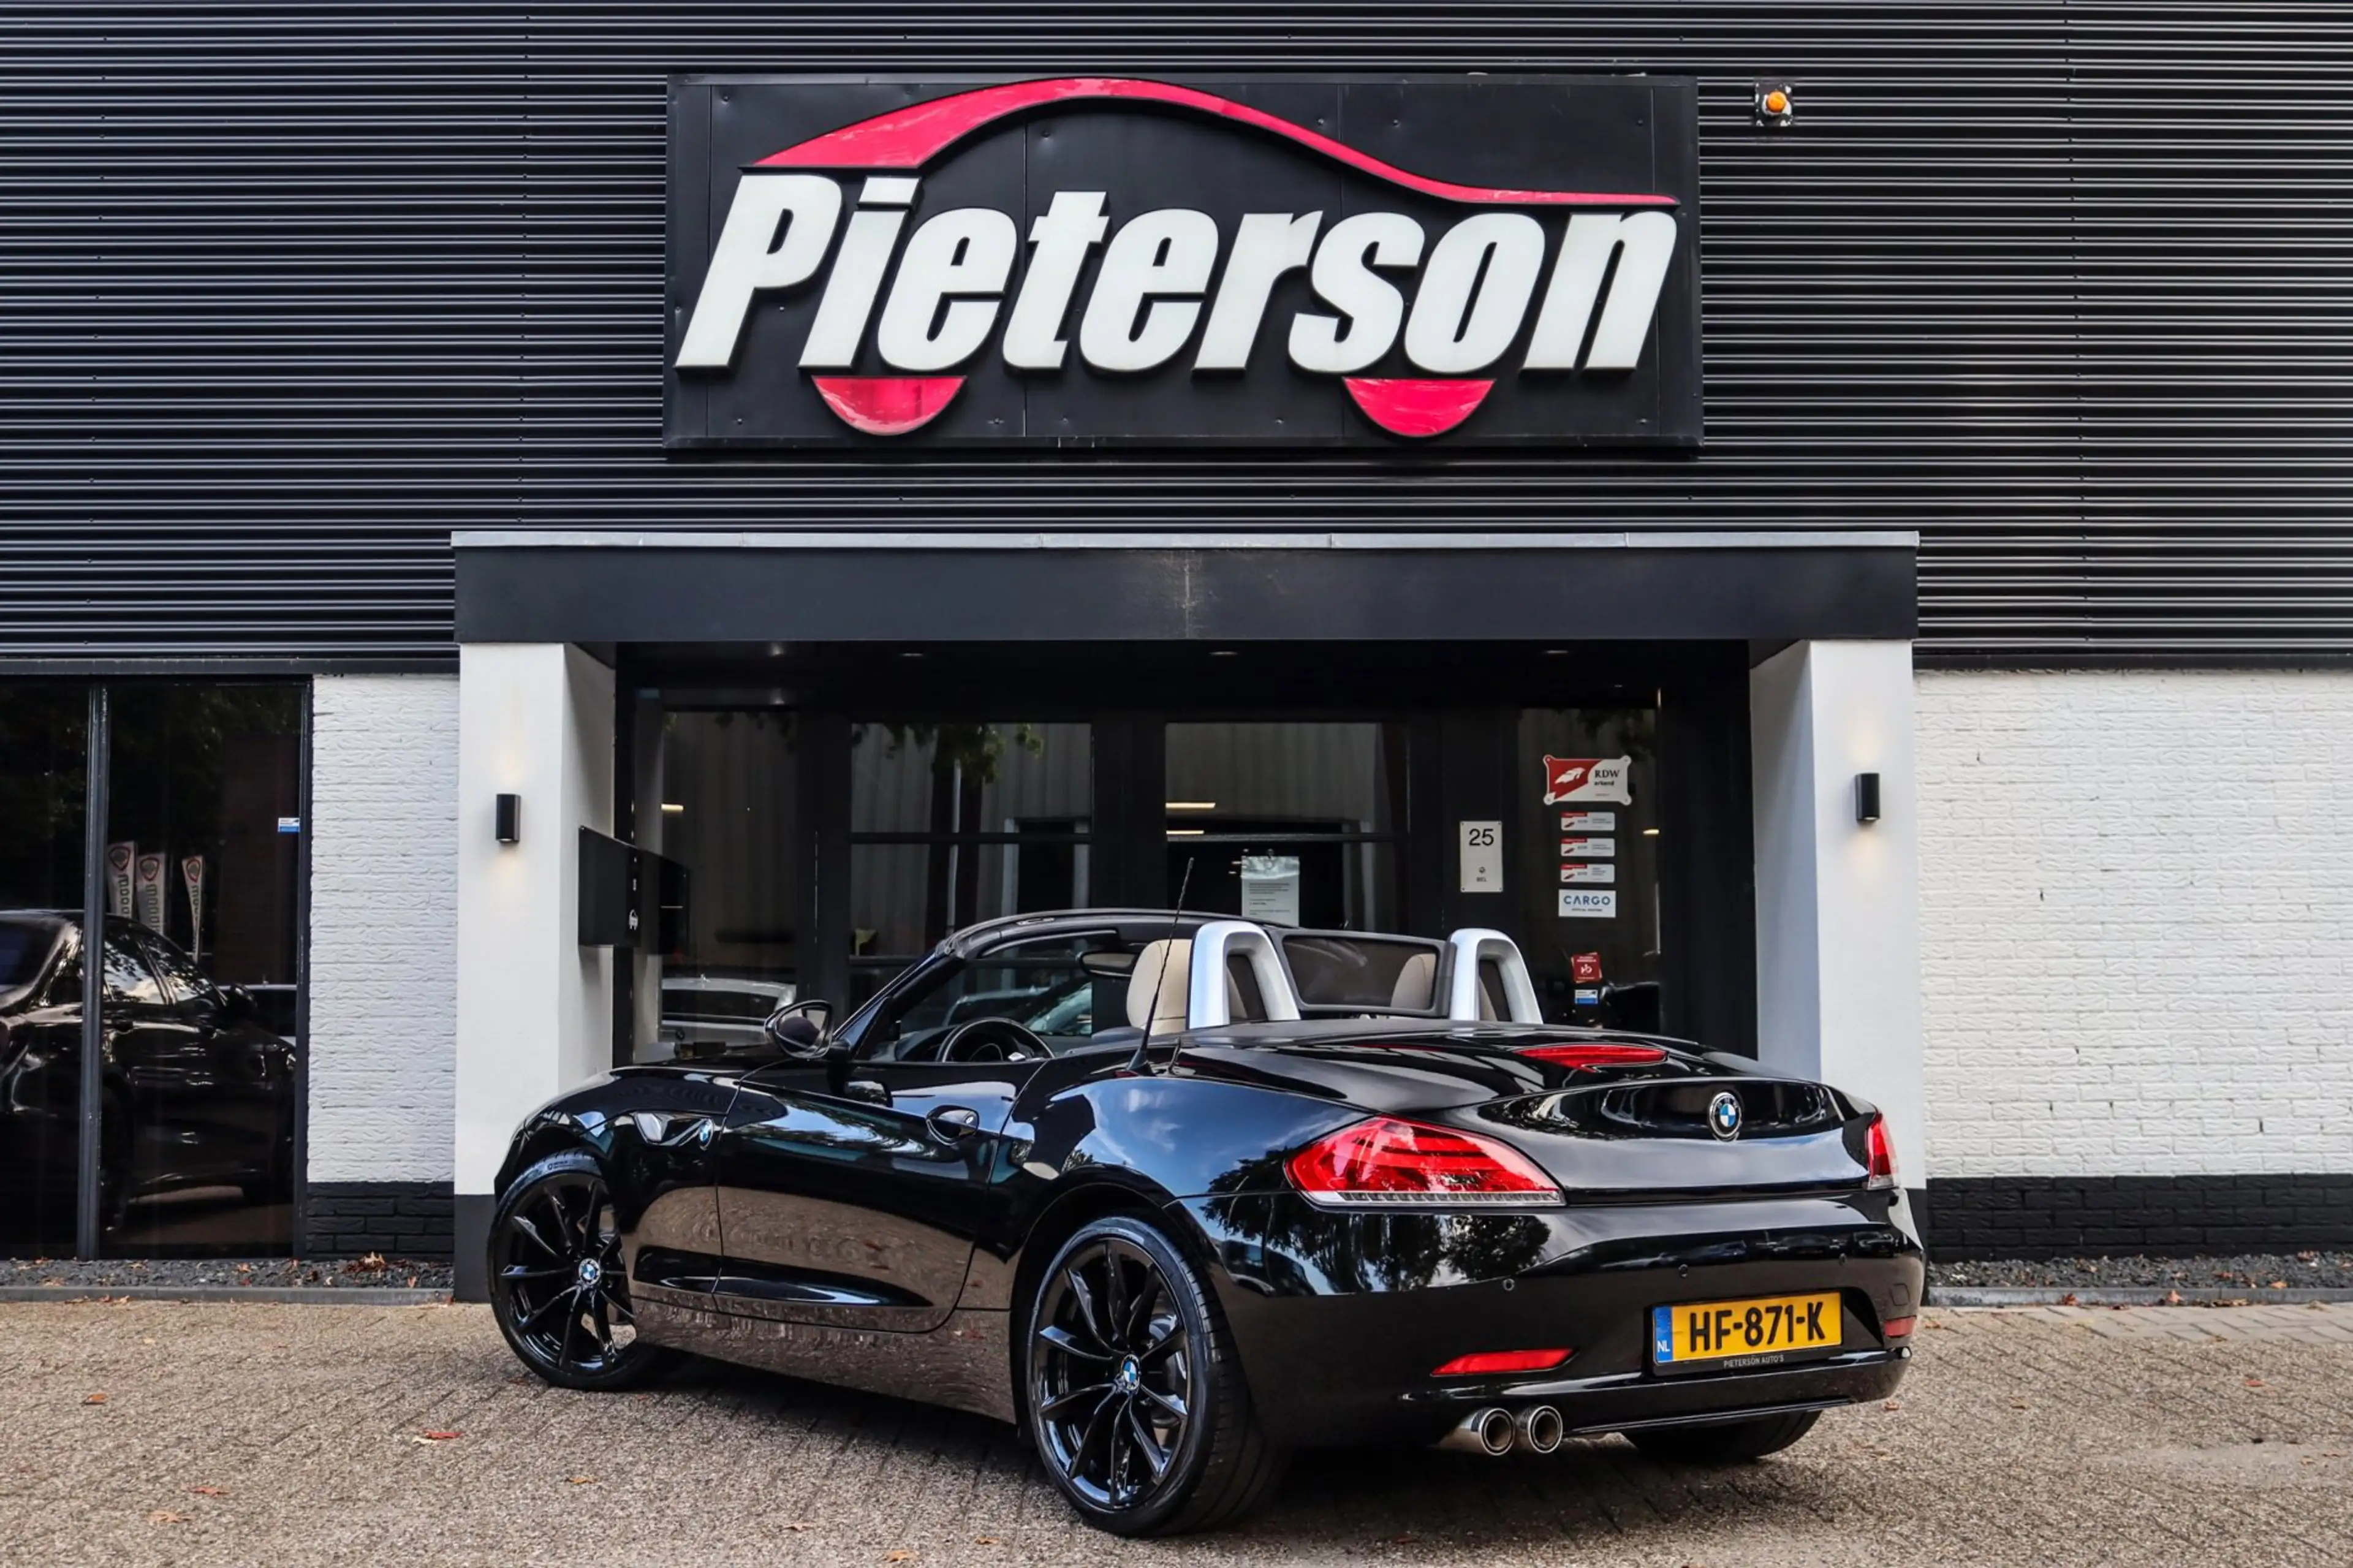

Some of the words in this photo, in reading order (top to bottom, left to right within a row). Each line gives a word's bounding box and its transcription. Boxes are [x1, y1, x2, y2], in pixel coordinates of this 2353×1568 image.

[676, 175, 1676, 372] Pieterson
[1594, 769, 1620, 778] RDW
[1469, 828, 1495, 846] 25
[1563, 895, 1611, 906] CARGO
[1689, 1301, 1826, 1352] HF-871-K
[1658, 1339, 1670, 1352] NL
[1723, 1357, 1761, 1369] PIETERSON
